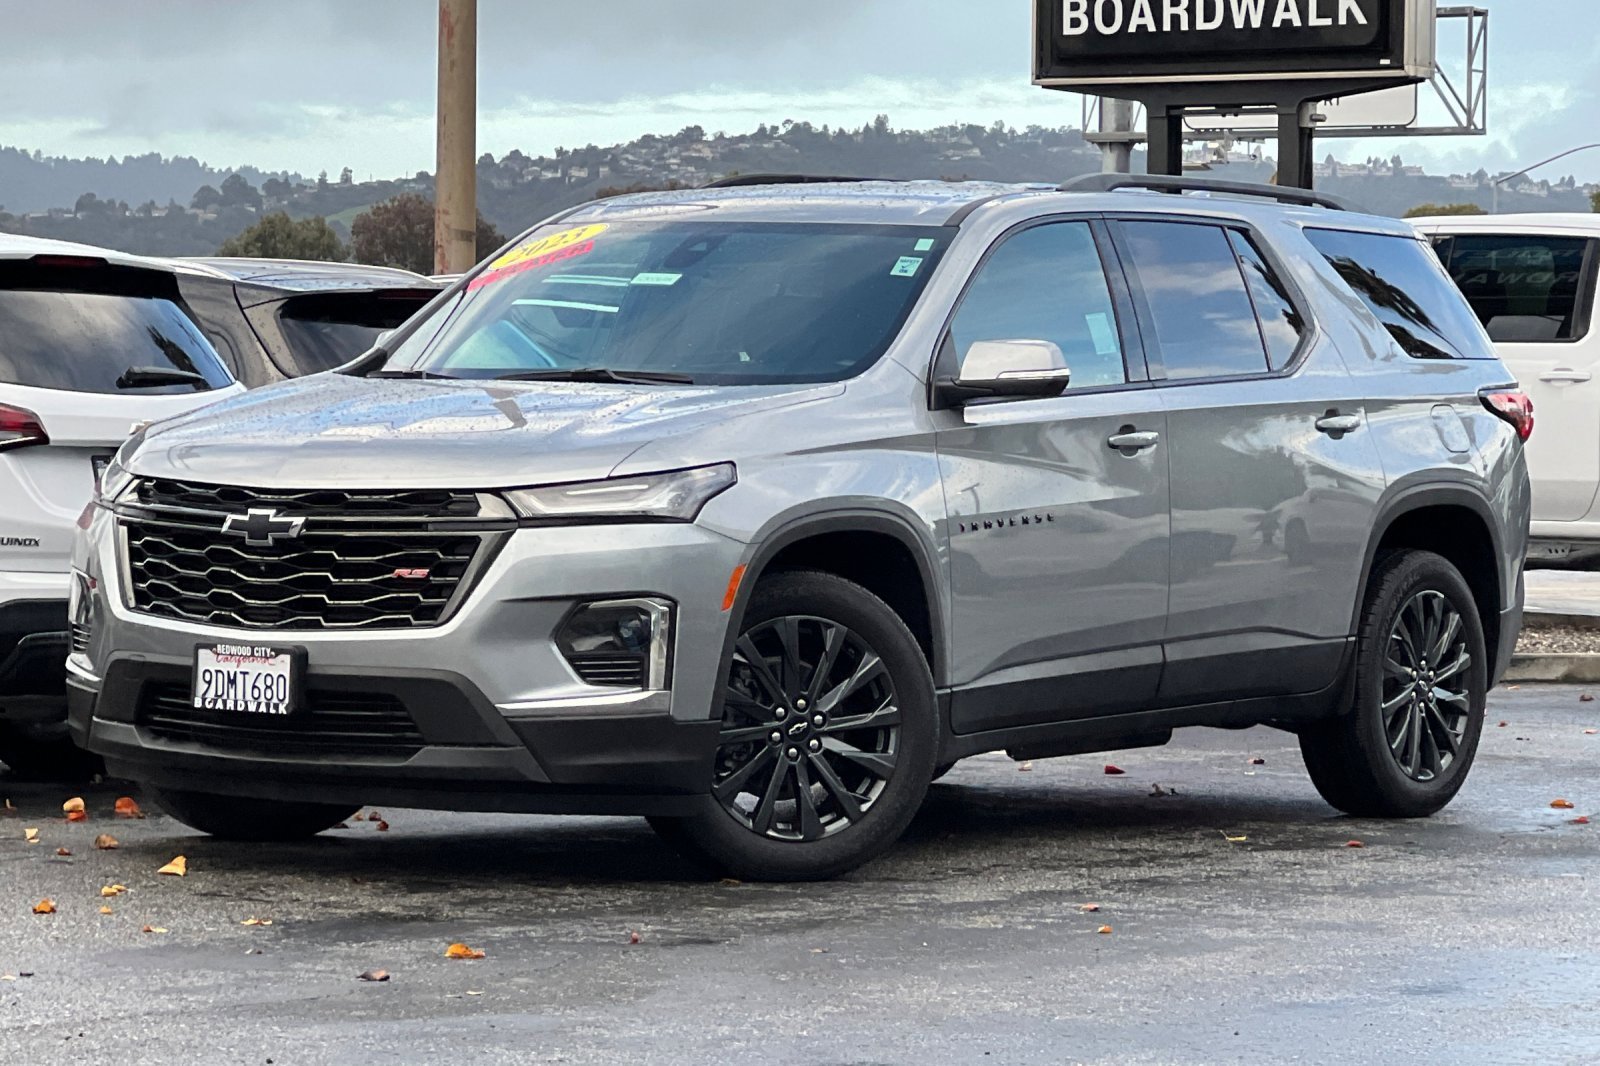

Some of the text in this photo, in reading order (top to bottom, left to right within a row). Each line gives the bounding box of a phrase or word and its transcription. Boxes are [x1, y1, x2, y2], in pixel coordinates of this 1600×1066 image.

[1062, 0, 1368, 36] BOARDWALK
[0, 536, 41, 547] UINOX
[216, 644, 272, 658] REDWOOD CITY
[202, 669, 287, 702] 9DMT680
[194, 697, 288, 715] BOARDWALK
